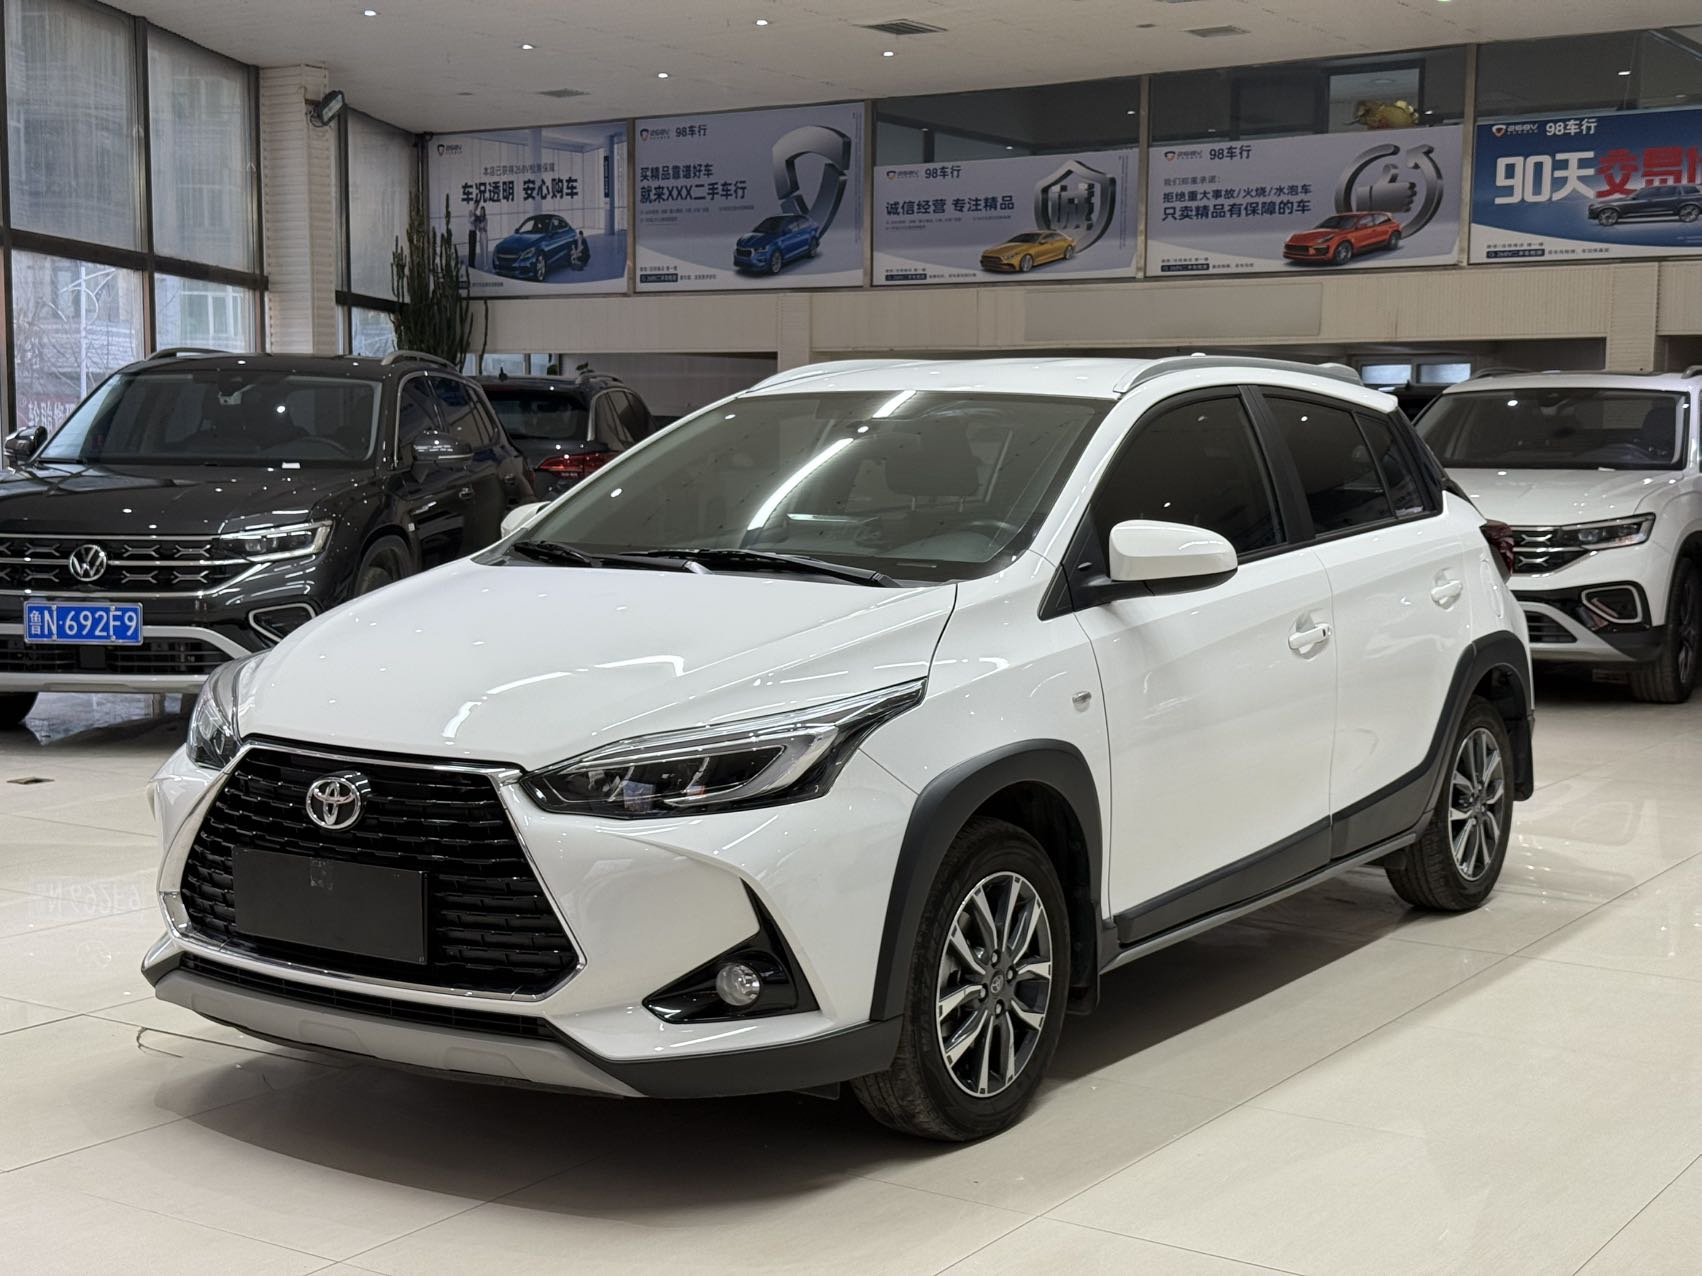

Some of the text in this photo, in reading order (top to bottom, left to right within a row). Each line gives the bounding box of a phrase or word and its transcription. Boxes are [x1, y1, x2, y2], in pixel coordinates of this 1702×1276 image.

[675, 124, 708, 138] 98车行
[1546, 118, 1597, 136] 98车行
[1209, 145, 1252, 160] 98车行
[640, 163, 713, 182] 买精品靠谱好车
[925, 165, 961, 180] 98车行
[461, 177, 578, 204] 车况透明 安心购车
[640, 180, 747, 204] 就来XXX二手车行
[1162, 183, 1312, 203] 拒绝重大事故/火烧/水泡车
[885, 195, 1015, 216] 诚信经营 专注精品
[1162, 199, 1311, 222] 只卖精品有保障的车
